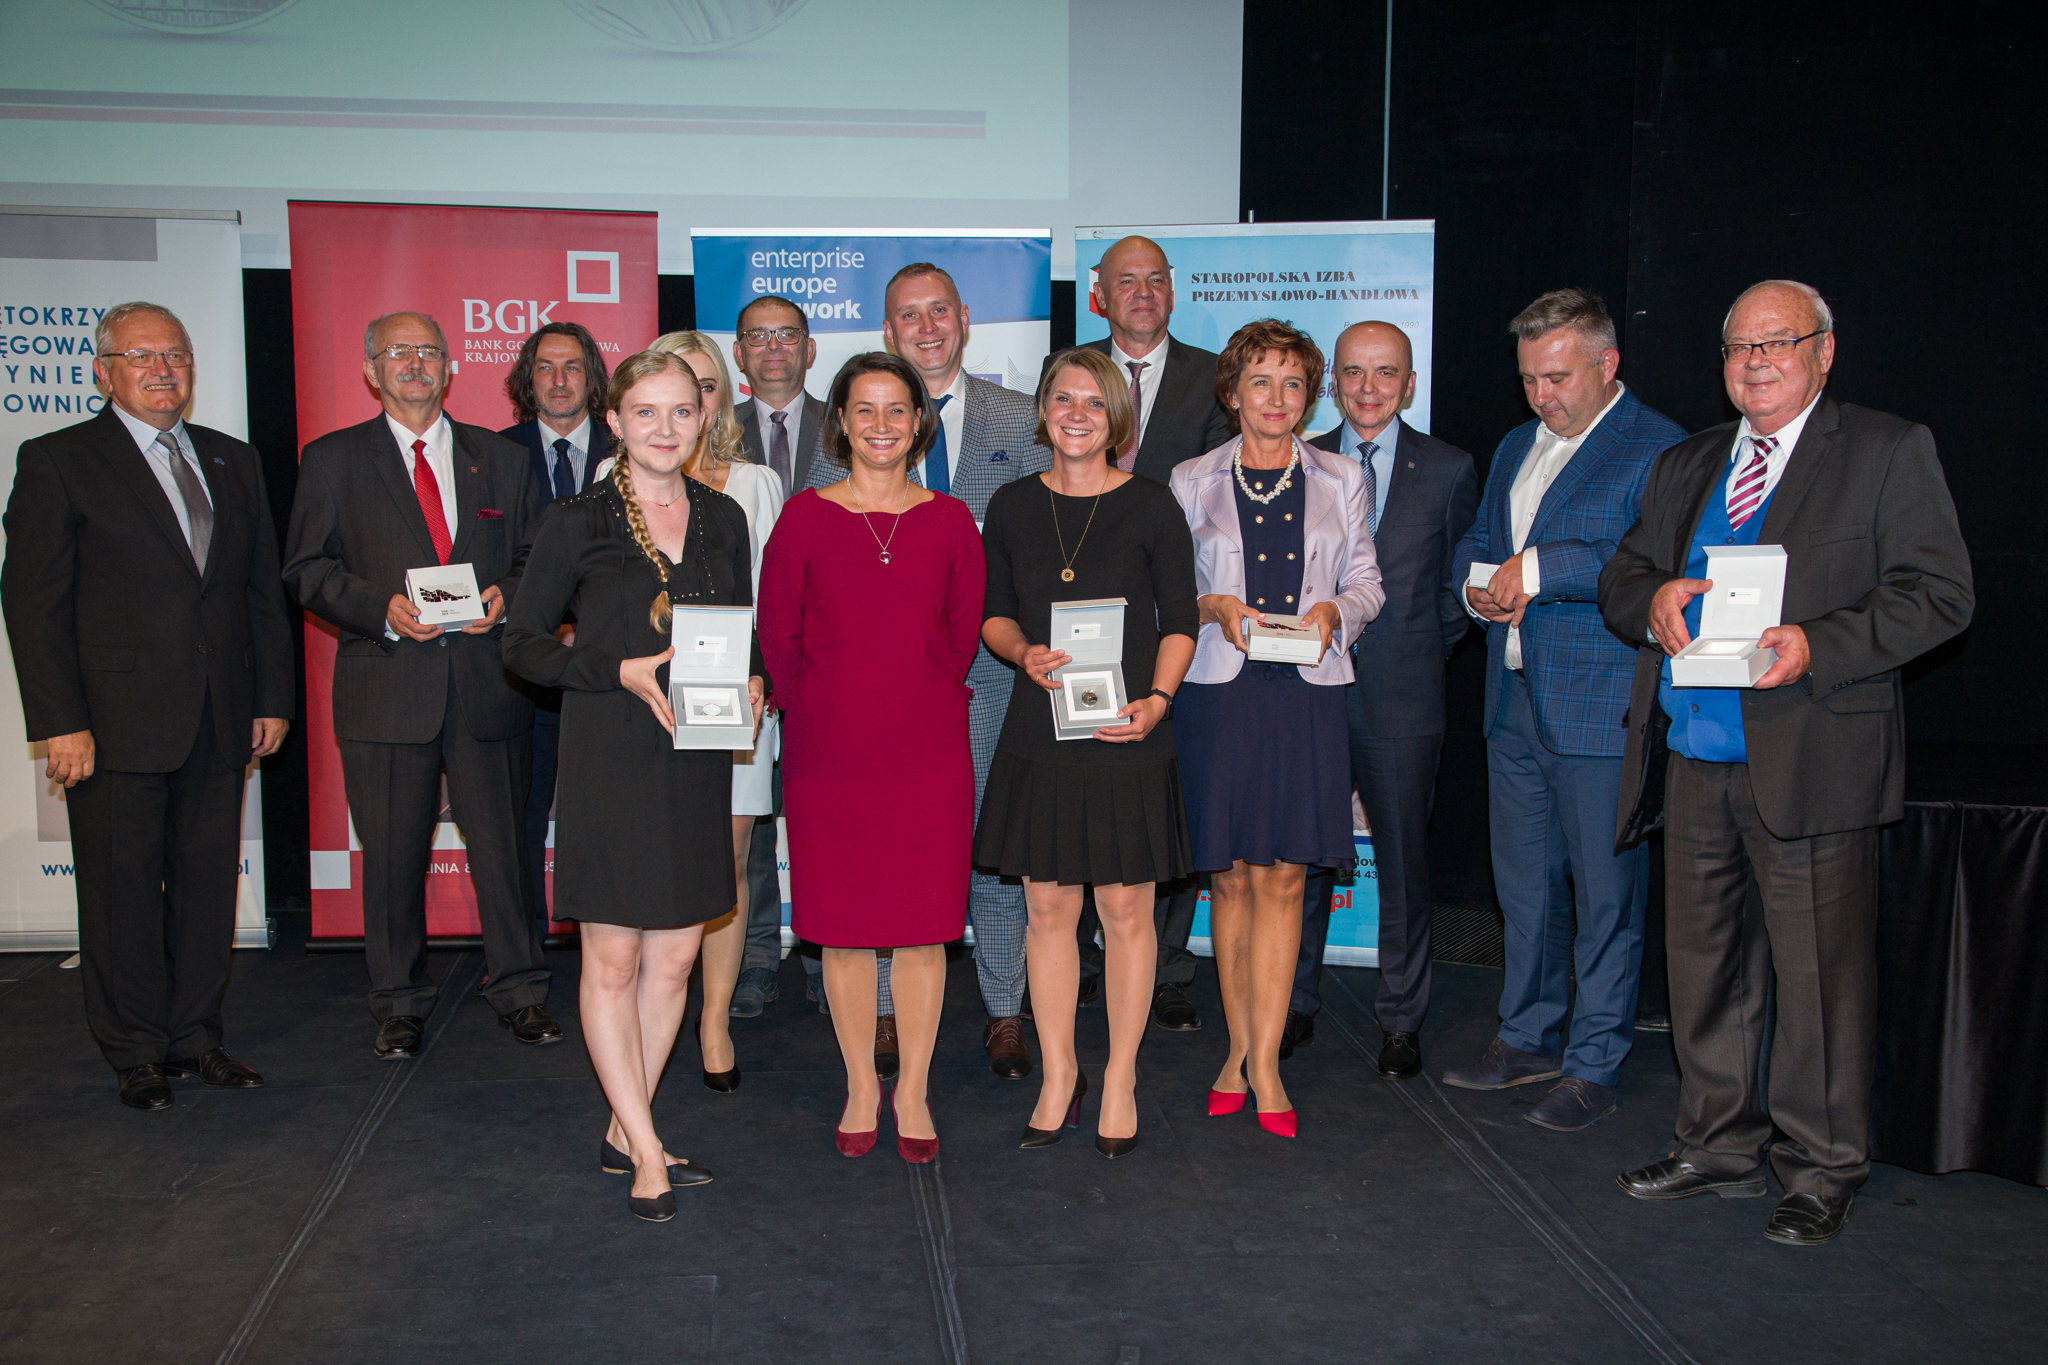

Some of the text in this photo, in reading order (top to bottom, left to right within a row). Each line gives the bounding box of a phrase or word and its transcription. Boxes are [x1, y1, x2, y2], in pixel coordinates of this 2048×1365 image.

[751, 246, 865, 274] enterprise
[1191, 270, 1356, 284] STAROPOLSKA IZBA
[752, 277, 837, 299] europe
[1191, 288, 1419, 302] PRZEMYSŁOWO-HANDLOWA
[462, 298, 560, 334] BGK
[789, 299, 862, 319] work
[1400, 321, 1420, 329] 1990
[465, 339, 502, 350] BANK
[594, 341, 621, 353] WA
